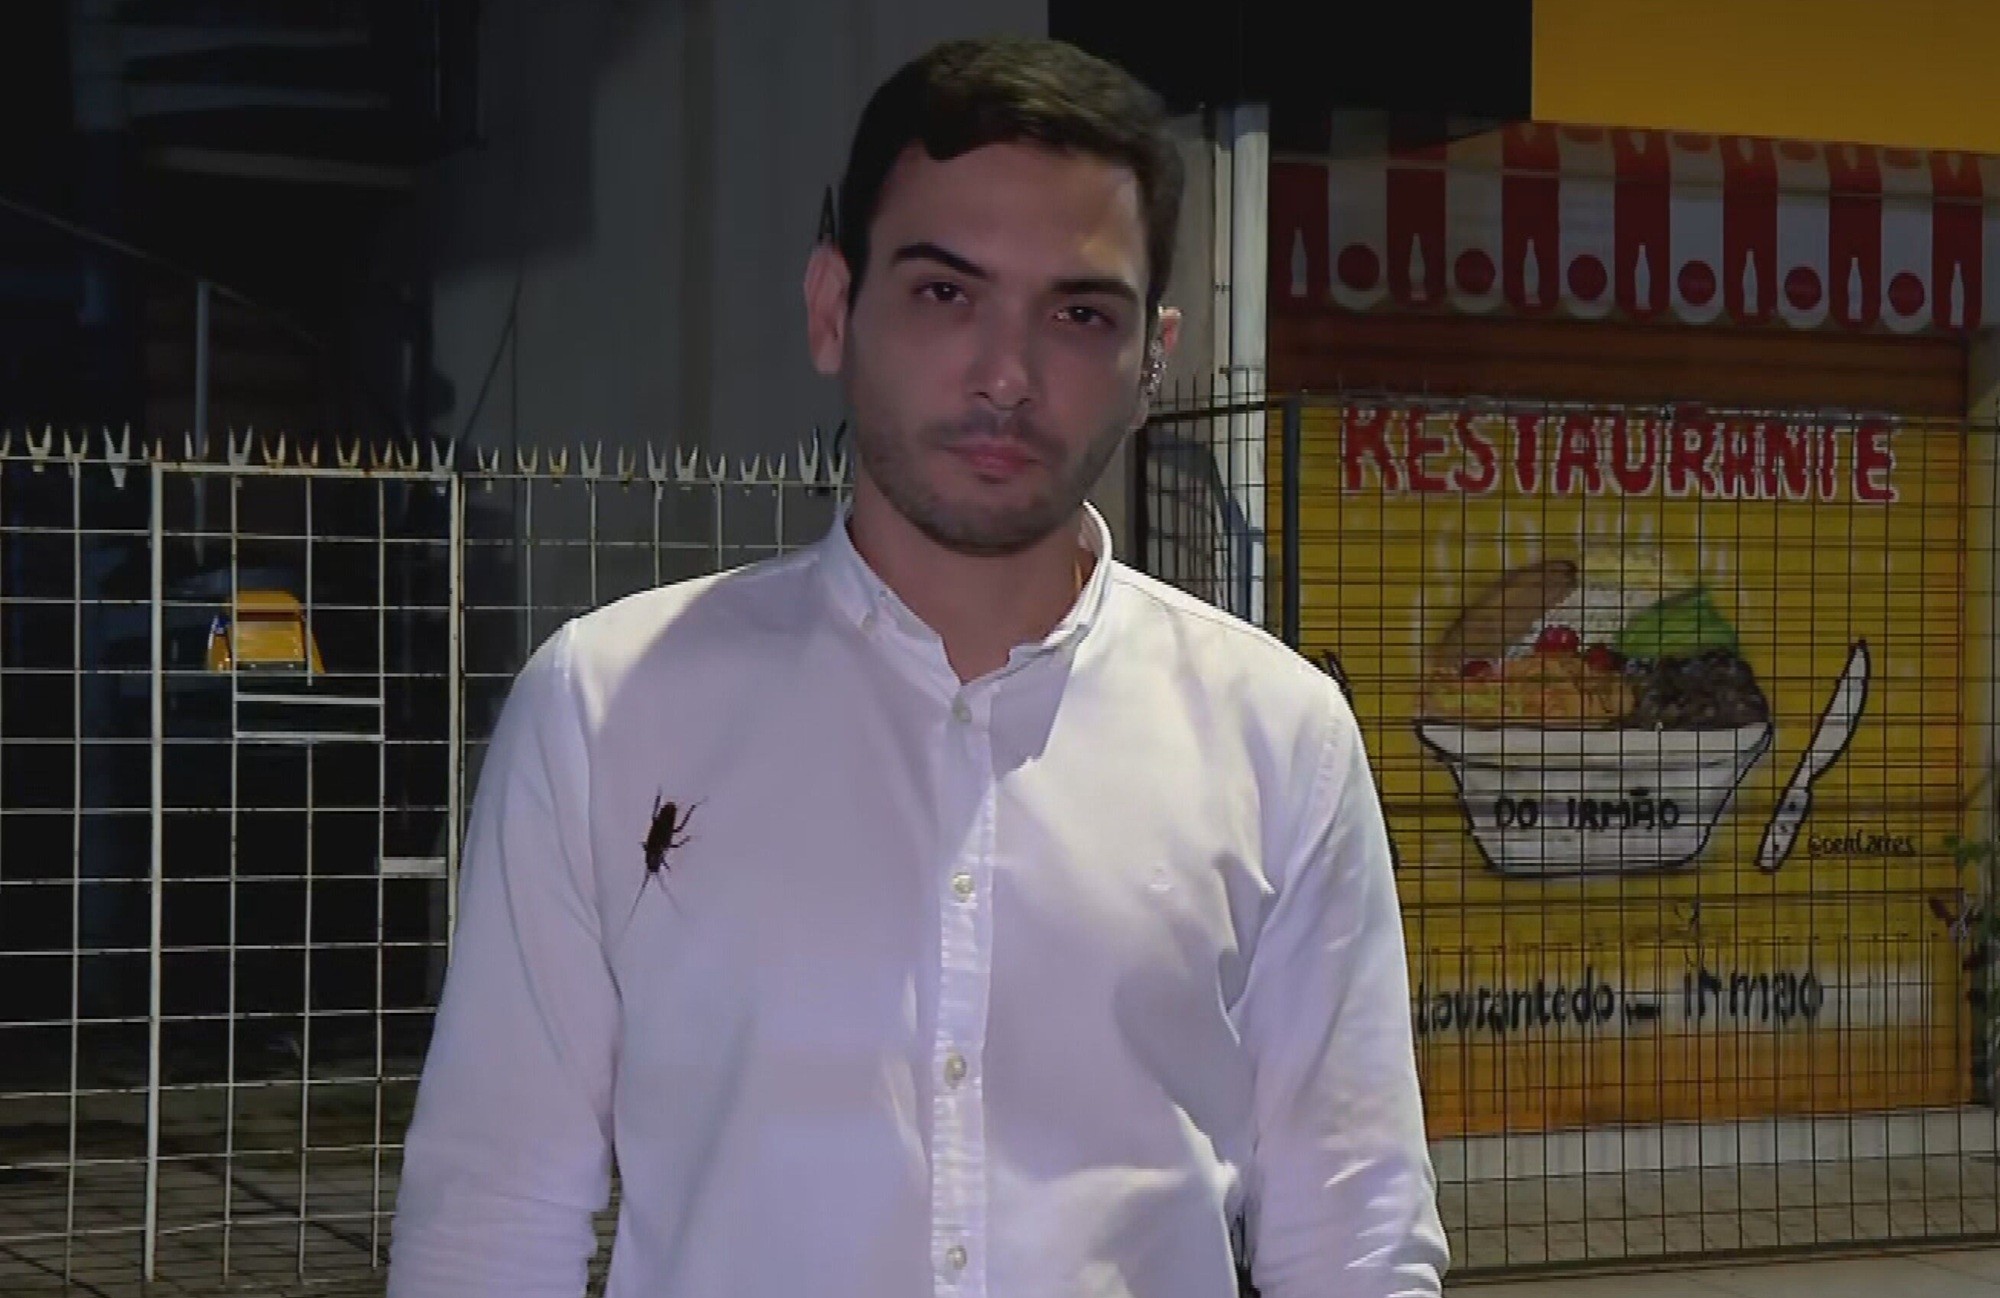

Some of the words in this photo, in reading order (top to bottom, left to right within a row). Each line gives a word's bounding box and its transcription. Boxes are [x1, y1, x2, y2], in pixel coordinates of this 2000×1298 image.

[1341, 406, 1899, 502] RESTAURANTE
[1494, 797, 1538, 830] DO
[1567, 788, 1680, 832] IRMÃO
